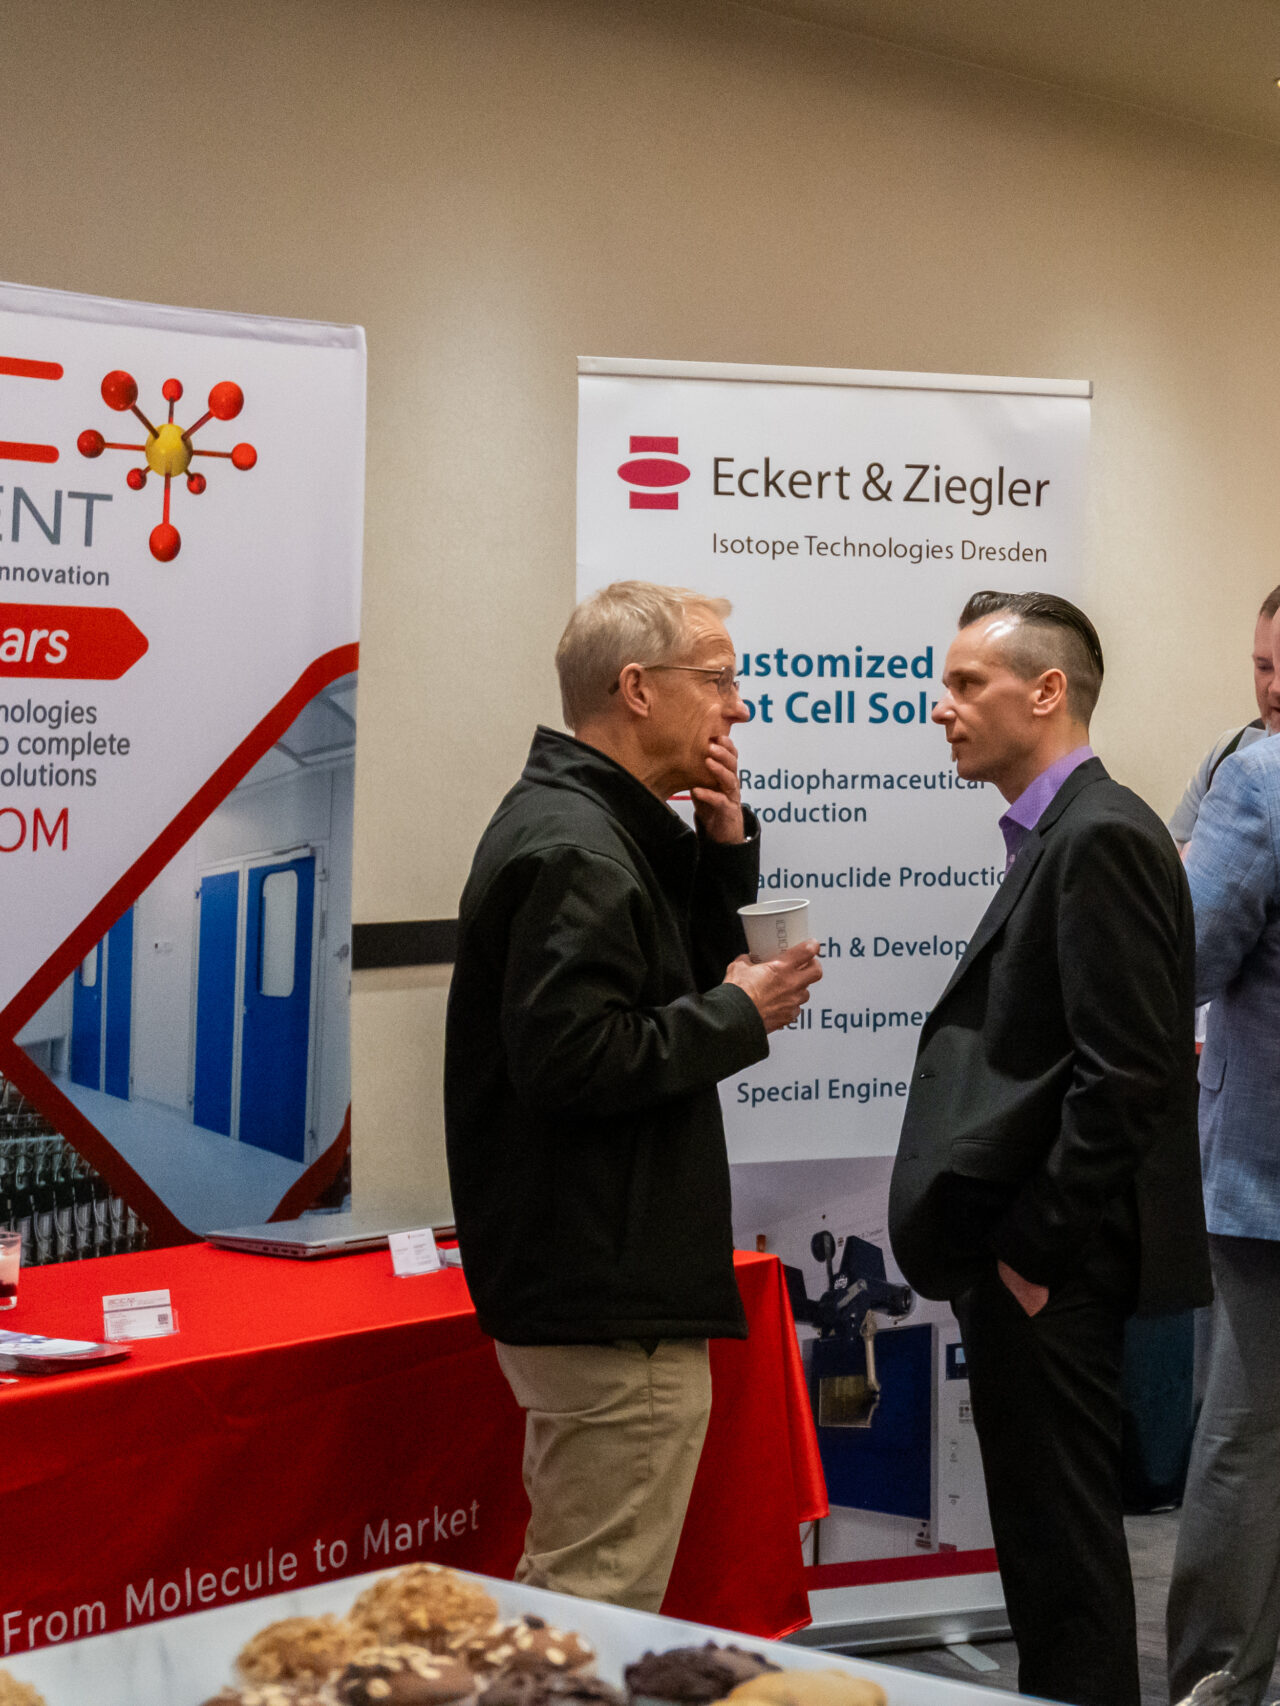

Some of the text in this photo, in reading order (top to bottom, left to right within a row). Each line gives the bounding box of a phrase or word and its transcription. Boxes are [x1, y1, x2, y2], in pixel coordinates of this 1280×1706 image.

[713, 456, 1050, 516] Eckert & Ziegler
[0, 485, 113, 547] NT
[713, 532, 1047, 565] Isotope Technologies Dresden
[736, 645, 934, 679] ustomized
[785, 690, 855, 724] Cell
[868, 691, 941, 724] Sol
[17, 730, 131, 761] complete
[743, 802, 867, 823] roduction
[757, 866, 891, 889] adionuclide
[849, 937, 866, 958] &
[821, 1008, 931, 1033] Equipme
[737, 1078, 911, 1108] Special Engine
[3, 1499, 480, 1655] From Molecule to Market
